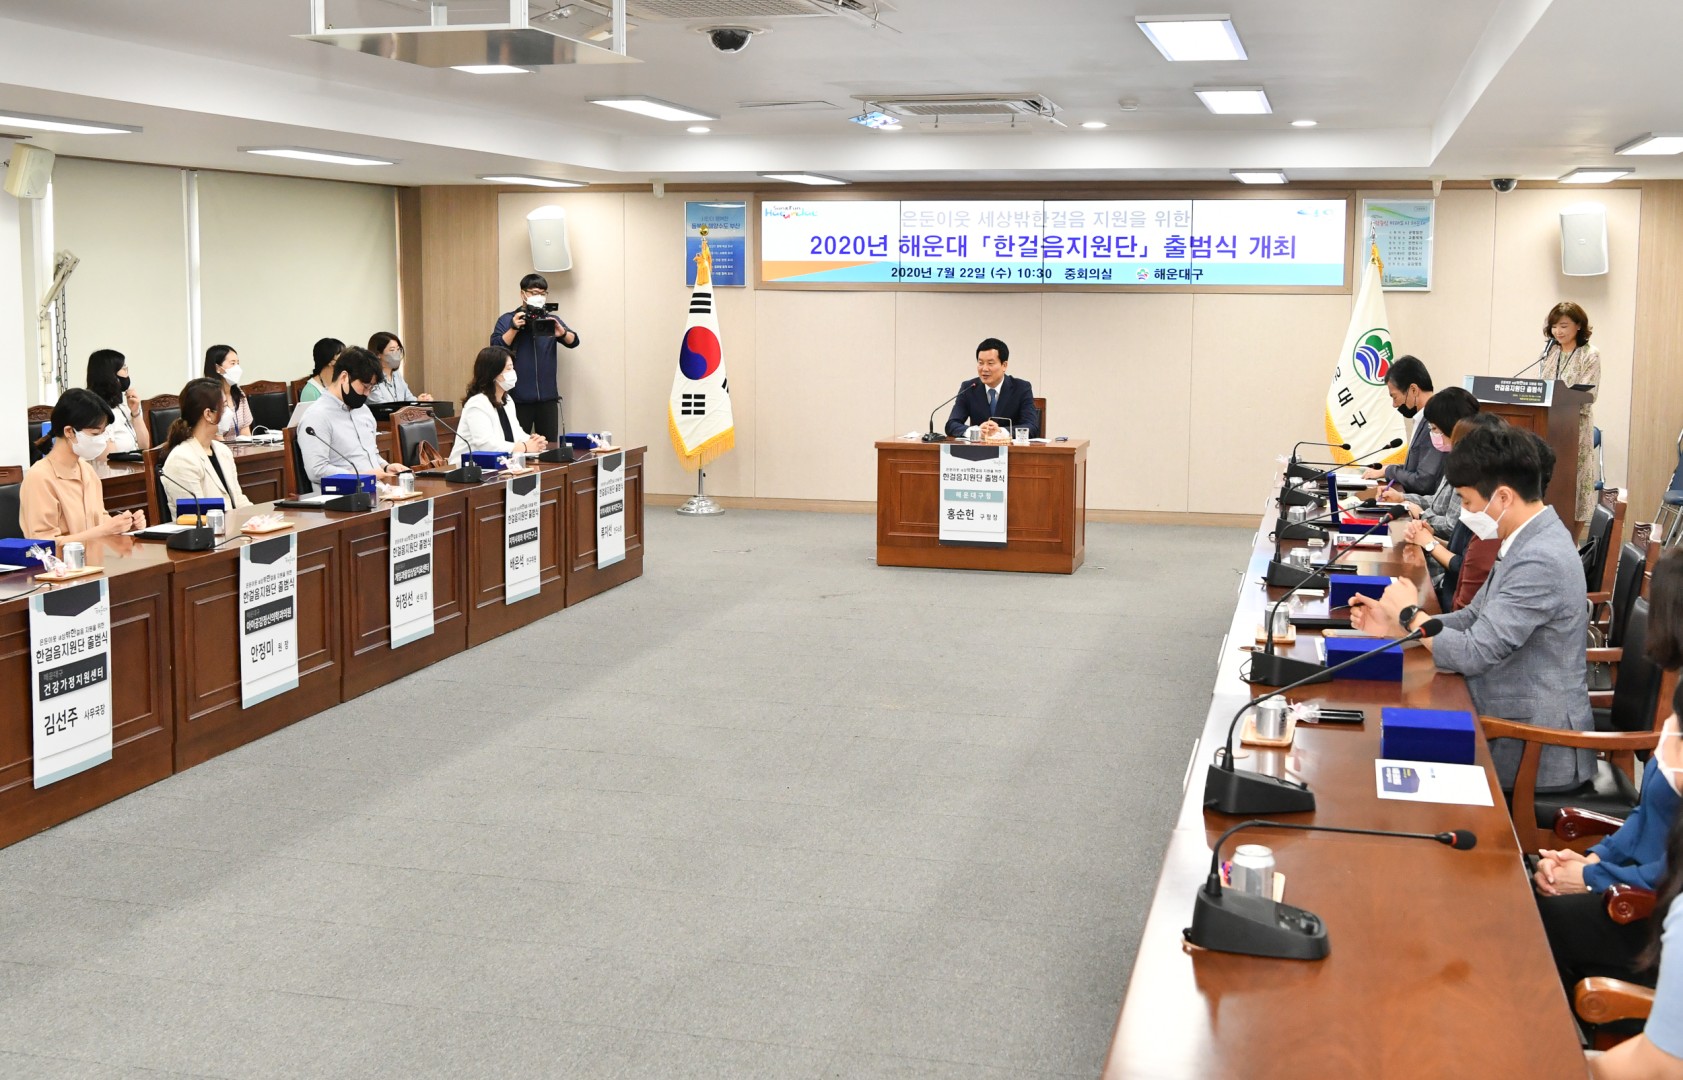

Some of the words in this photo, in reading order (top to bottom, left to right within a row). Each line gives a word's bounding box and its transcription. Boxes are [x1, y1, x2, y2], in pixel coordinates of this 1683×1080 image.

[901, 210, 971, 228] 은둔이웃
[978, 210, 1086, 228] 세상밖한걸음
[1093, 210, 1146, 228] 지원을
[1154, 210, 1190, 228] 위한
[810, 235, 888, 257] 2020년
[898, 235, 967, 257] 해운대
[1164, 235, 1237, 258] 출범식
[1249, 235, 1296, 259] 개최
[891, 267, 932, 279] 2020년
[937, 267, 955, 279] 7월
[960, 267, 986, 279] 22일
[991, 267, 1012, 279] (수)
[1018, 267, 1052, 279] 10:30
[1065, 267, 1112, 280] 중회의실
[1154, 268, 1204, 280] 해운대구
[946, 508, 974, 520] 홍순헌
[243, 582, 277, 604] 한걸음지원단
[278, 576, 295, 593] 출범식
[36, 638, 85, 664] 한걸음지원단
[87, 630, 108, 650] 출범식
[250, 638, 274, 663] 안정미
[44, 666, 104, 696] 건강가정지원센터
[44, 707, 78, 736] 김선주
[84, 703, 106, 720] 사무국장
